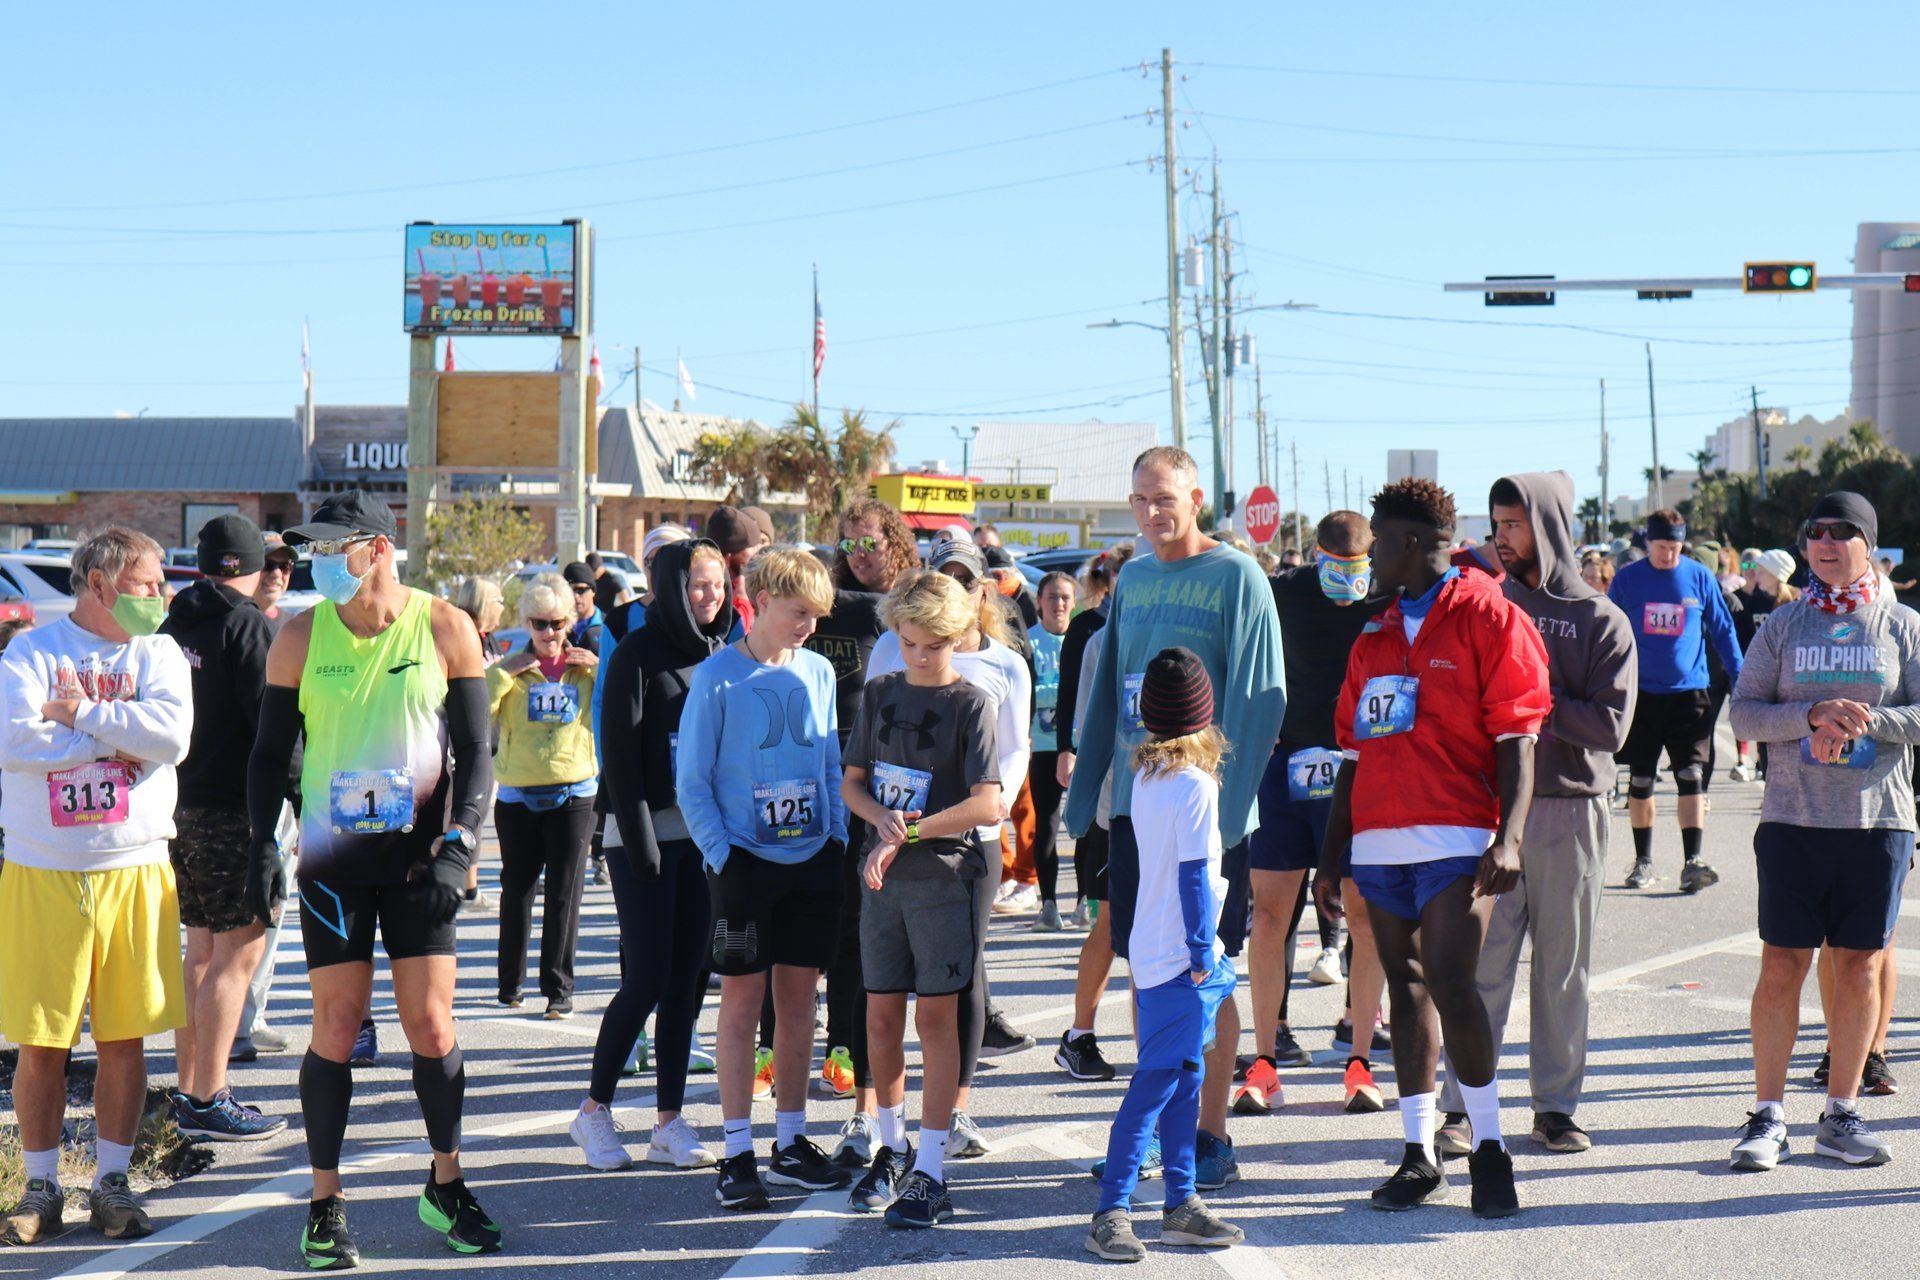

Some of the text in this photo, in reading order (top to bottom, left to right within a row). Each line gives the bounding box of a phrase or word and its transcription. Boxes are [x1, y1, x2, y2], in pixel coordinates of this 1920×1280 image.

[432, 231, 547, 250] Stop by for a
[431, 306, 546, 322] Frozen Drink
[974, 487, 1047, 500] HOUSE
[1247, 502, 1279, 528] STOP
[1650, 613, 1677, 628] 314
[823, 640, 853, 657] DAT
[1795, 645, 1887, 672] DOLPHINS
[316, 665, 355, 674] BEASTS
[536, 695, 571, 713] 112
[1368, 693, 1397, 724] 97
[53, 772, 71, 781] MAKE
[93, 769, 106, 778] THE
[107, 768, 123, 777] LINE
[332, 777, 354, 787] MAKE
[913, 776, 929, 788] LINE
[1304, 762, 1335, 788] 79
[62, 781, 116, 813] 313
[754, 789, 773, 799] MAKE
[803, 784, 817, 794] LINE
[878, 782, 916, 811] 127
[364, 790, 379, 819] 1
[766, 797, 813, 828] 125
